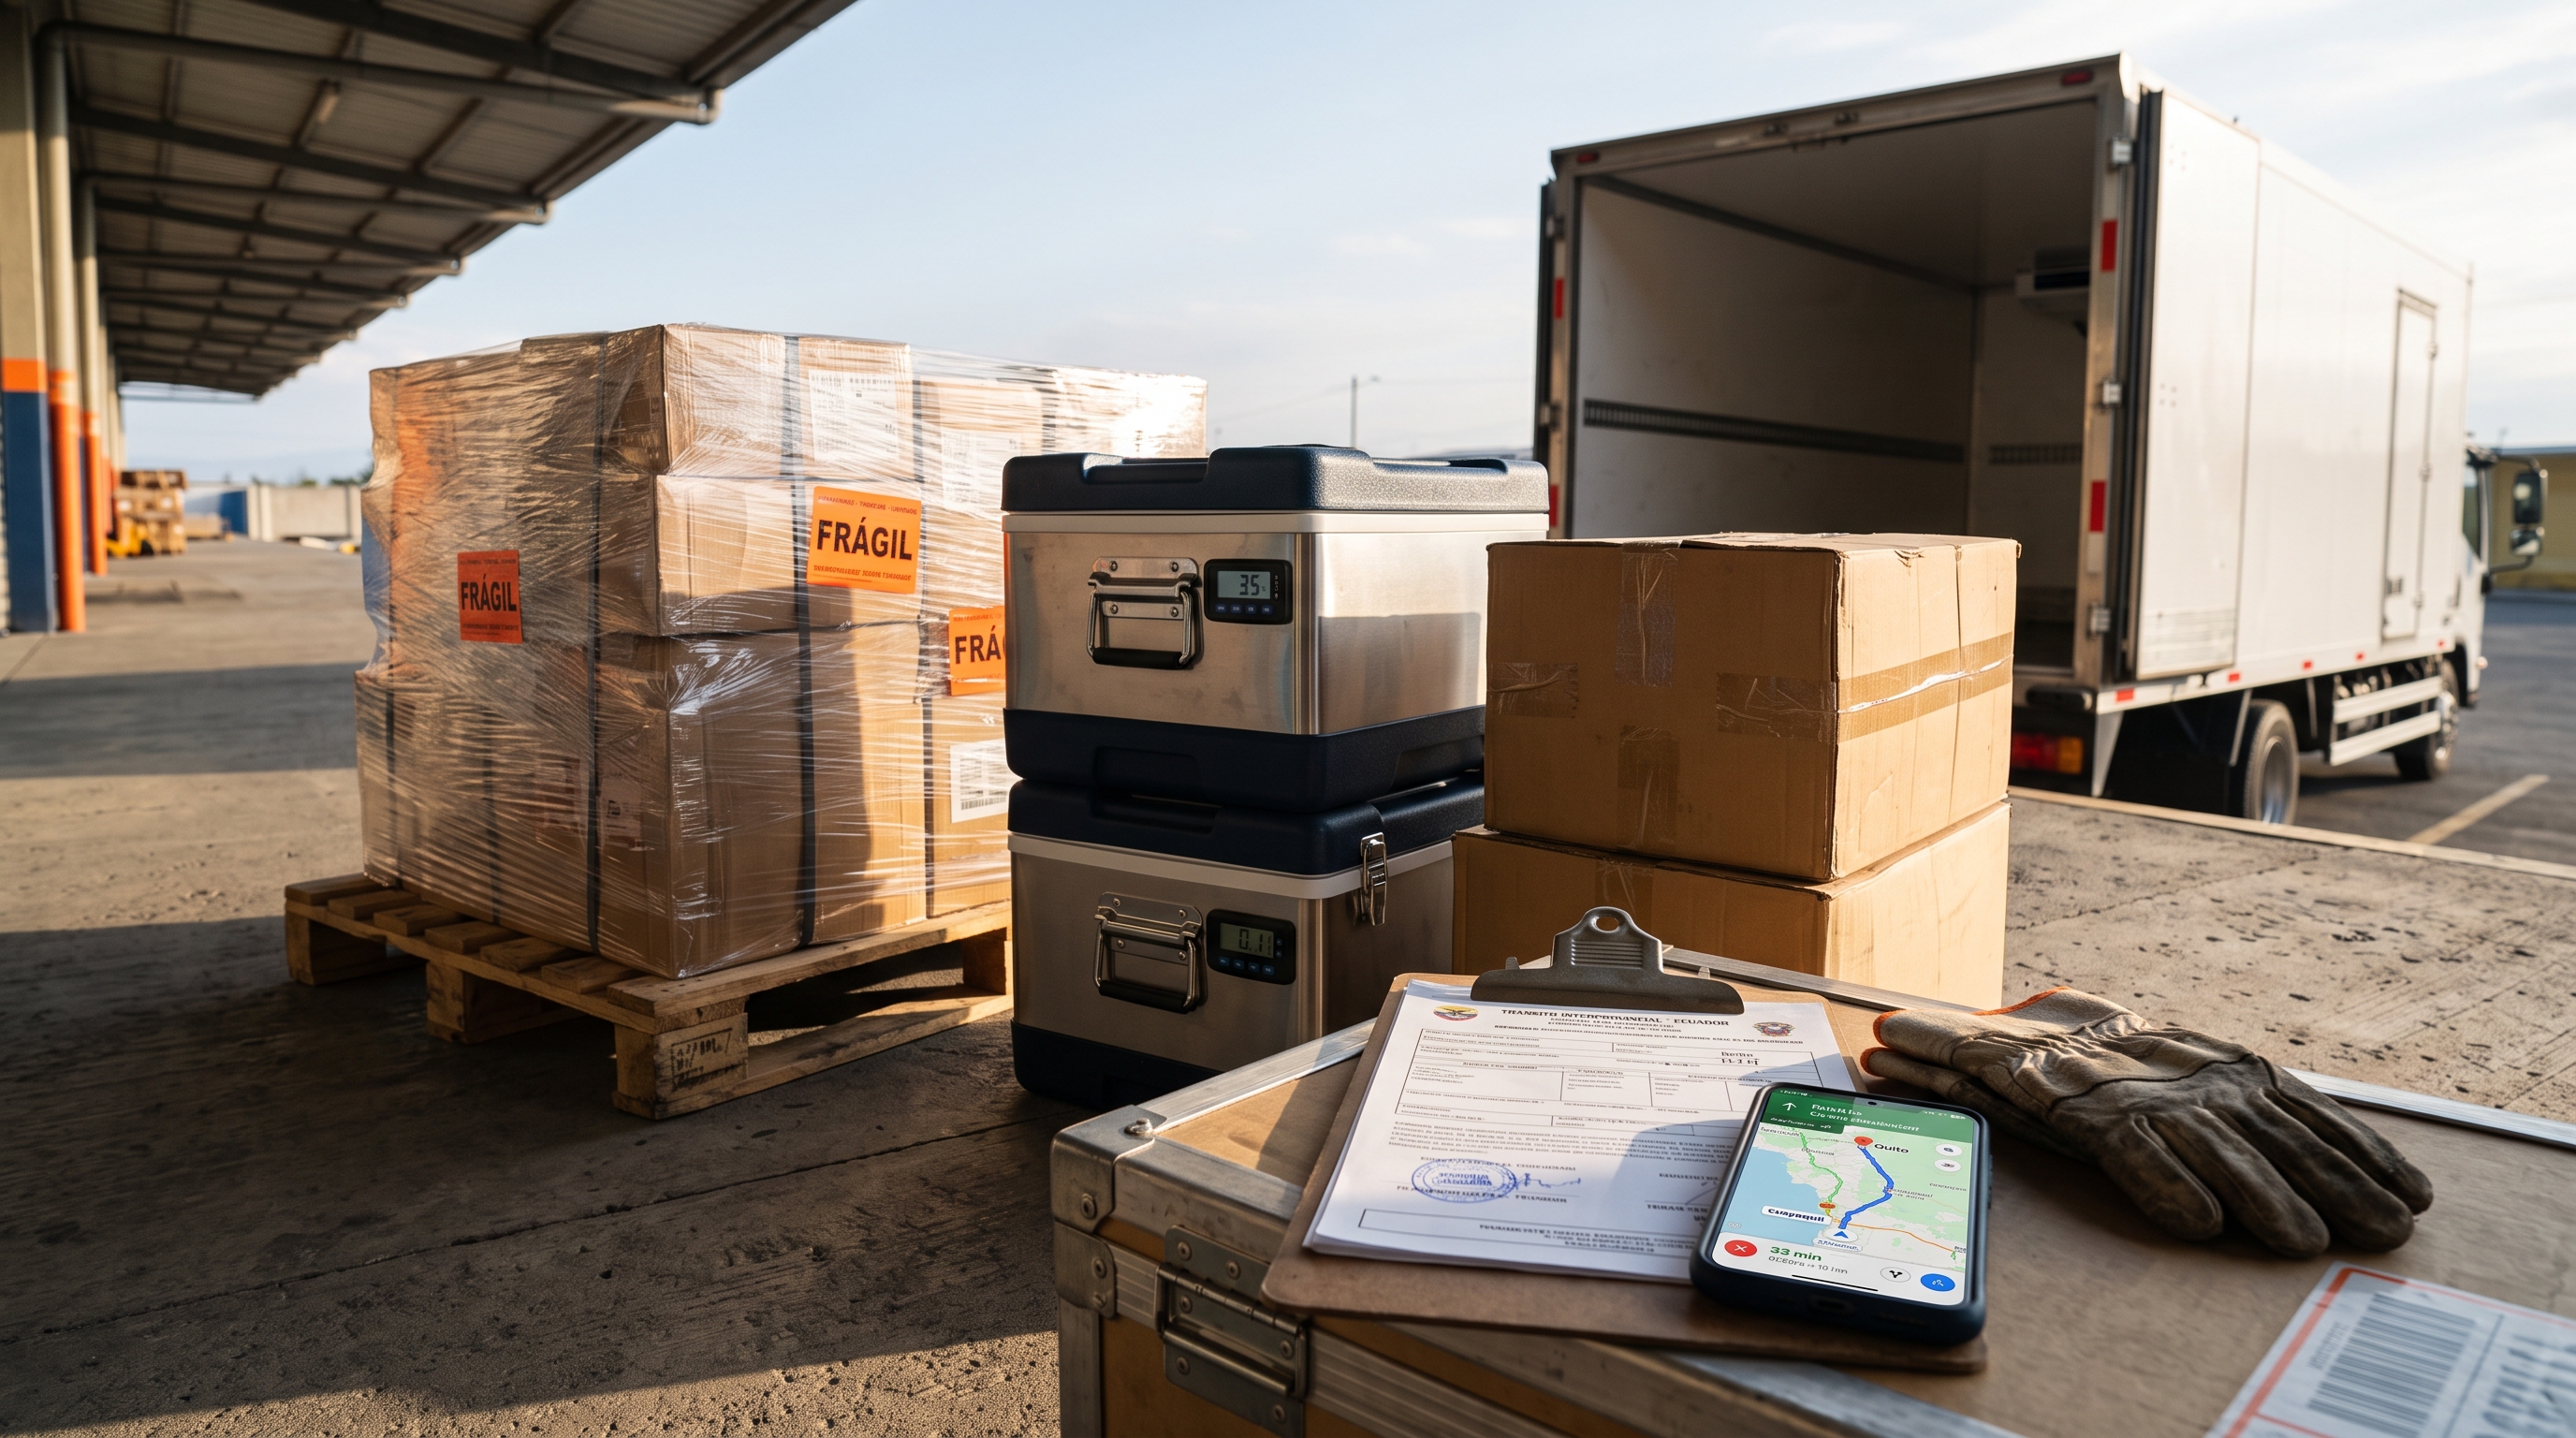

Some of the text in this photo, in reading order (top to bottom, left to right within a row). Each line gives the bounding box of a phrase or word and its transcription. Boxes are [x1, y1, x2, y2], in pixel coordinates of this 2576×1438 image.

[817, 517, 913, 561] FRÁGIL
[461, 573, 517, 611] FRÁGIL
[1239, 574, 1260, 596] 35
[955, 624, 1005, 664] FRÁ
[1770, 1246, 1822, 1261] 33 min
